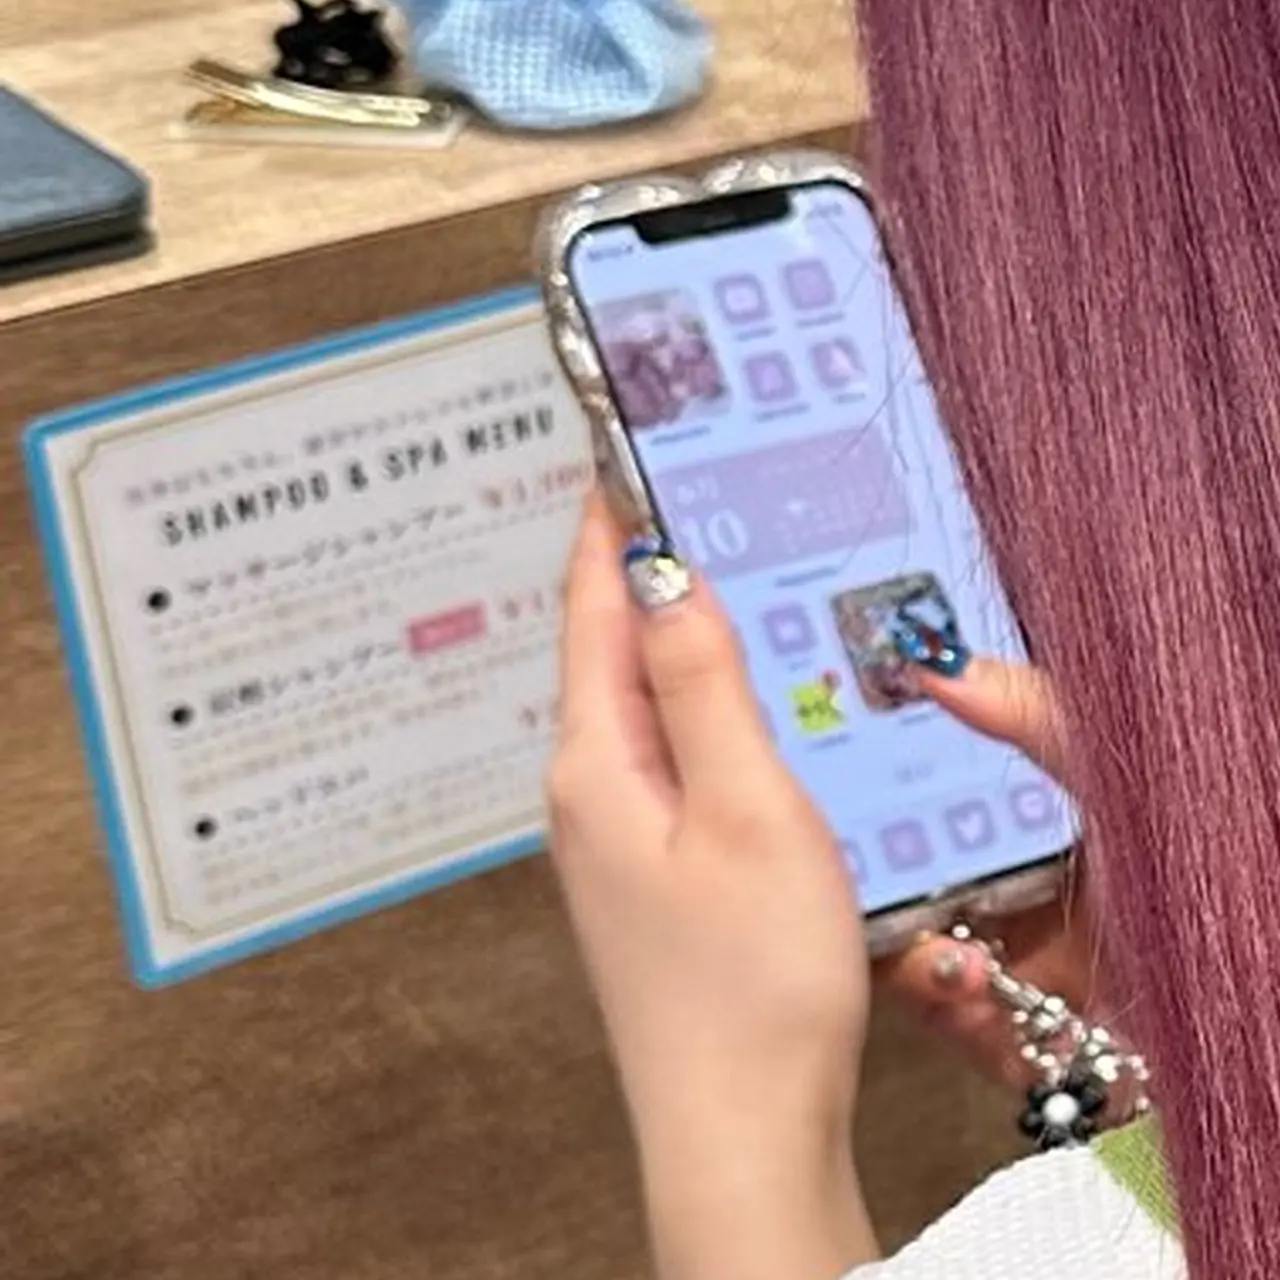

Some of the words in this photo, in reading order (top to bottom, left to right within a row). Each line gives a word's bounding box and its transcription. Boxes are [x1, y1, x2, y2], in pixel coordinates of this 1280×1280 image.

[162, 470, 332, 548] SHAMPOO
[348, 458, 369, 493] &
[383, 436, 448, 483] SPA
[465, 404, 555, 458] MENU
